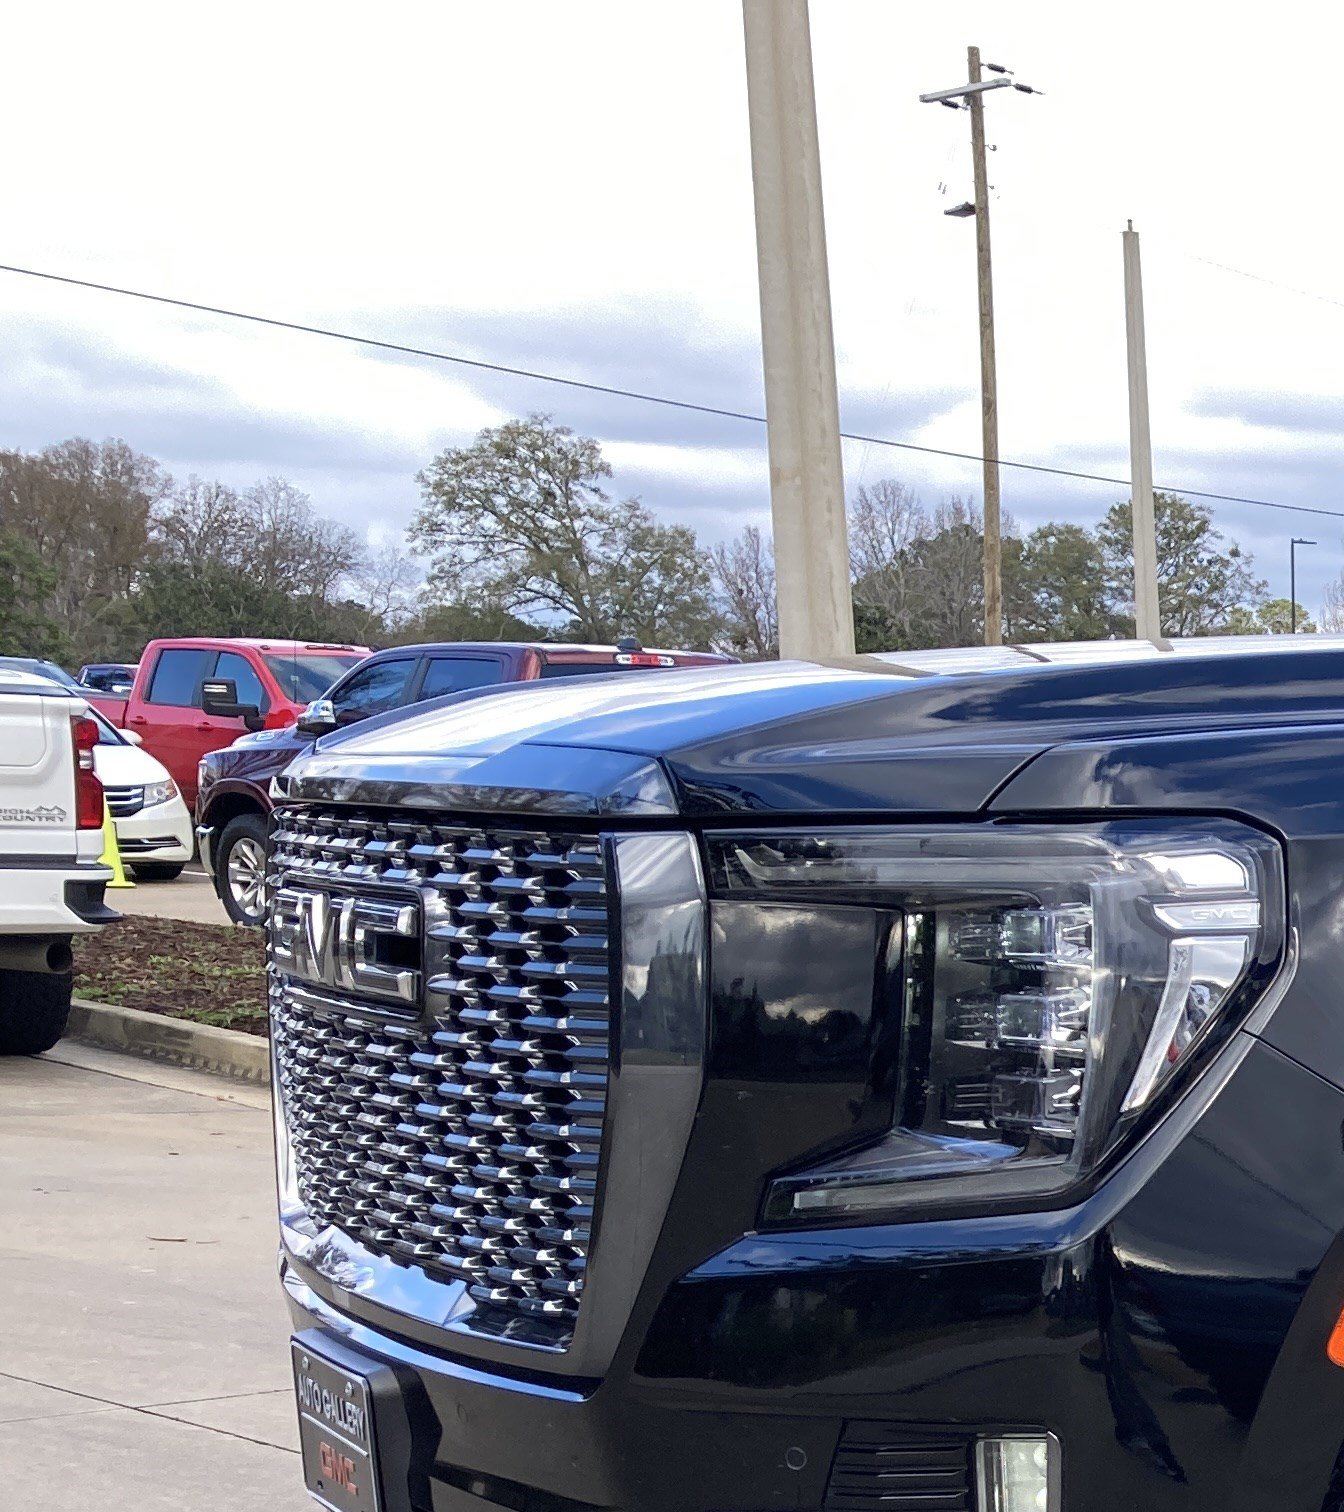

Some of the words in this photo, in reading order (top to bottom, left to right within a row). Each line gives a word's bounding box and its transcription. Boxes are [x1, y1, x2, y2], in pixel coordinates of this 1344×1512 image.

[1191, 907, 1251, 920] GMC
[299, 1374, 322, 1414] AUTO
[321, 1387, 366, 1441] GALLERY
[319, 1441, 359, 1496] GMC
